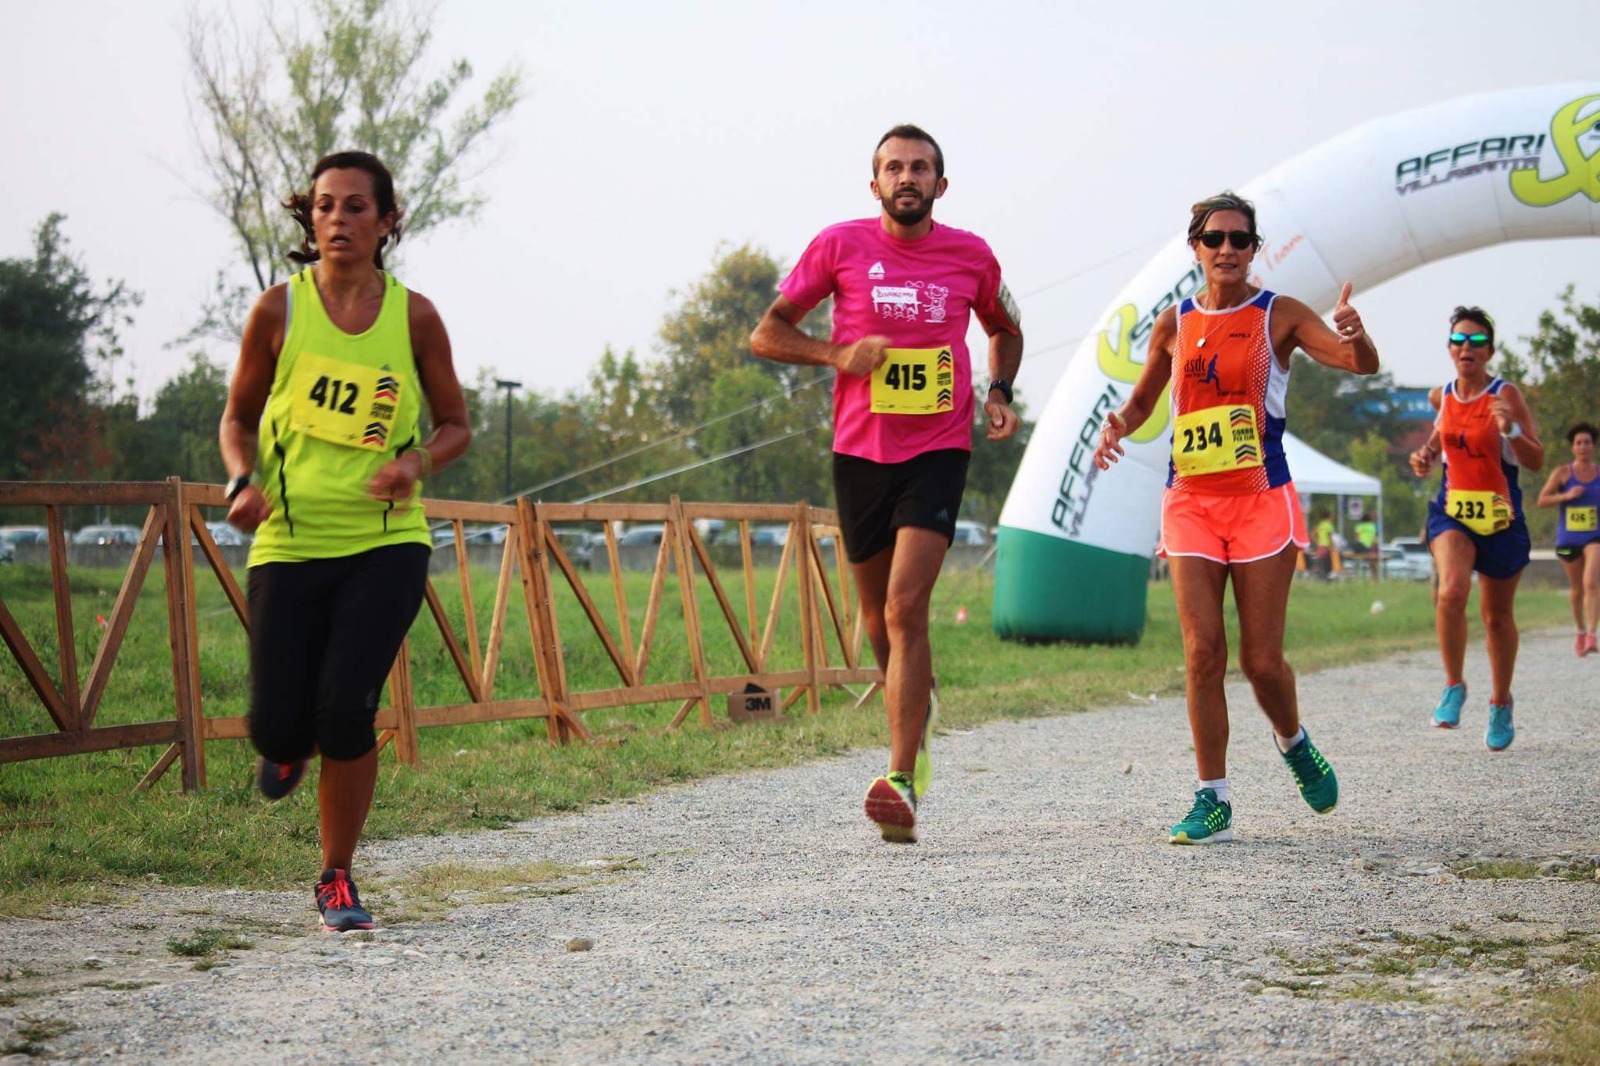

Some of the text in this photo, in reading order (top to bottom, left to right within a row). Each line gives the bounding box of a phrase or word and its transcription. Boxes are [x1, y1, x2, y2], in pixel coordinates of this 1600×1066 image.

[1395, 134, 1547, 184] AFFARI
[885, 363, 927, 391] 415
[309, 375, 359, 415] 412
[1182, 421, 1223, 453] 234
[1051, 383, 1122, 534] AFFARI
[1454, 500, 1486, 519] 232
[745, 697, 771, 711] 3M
